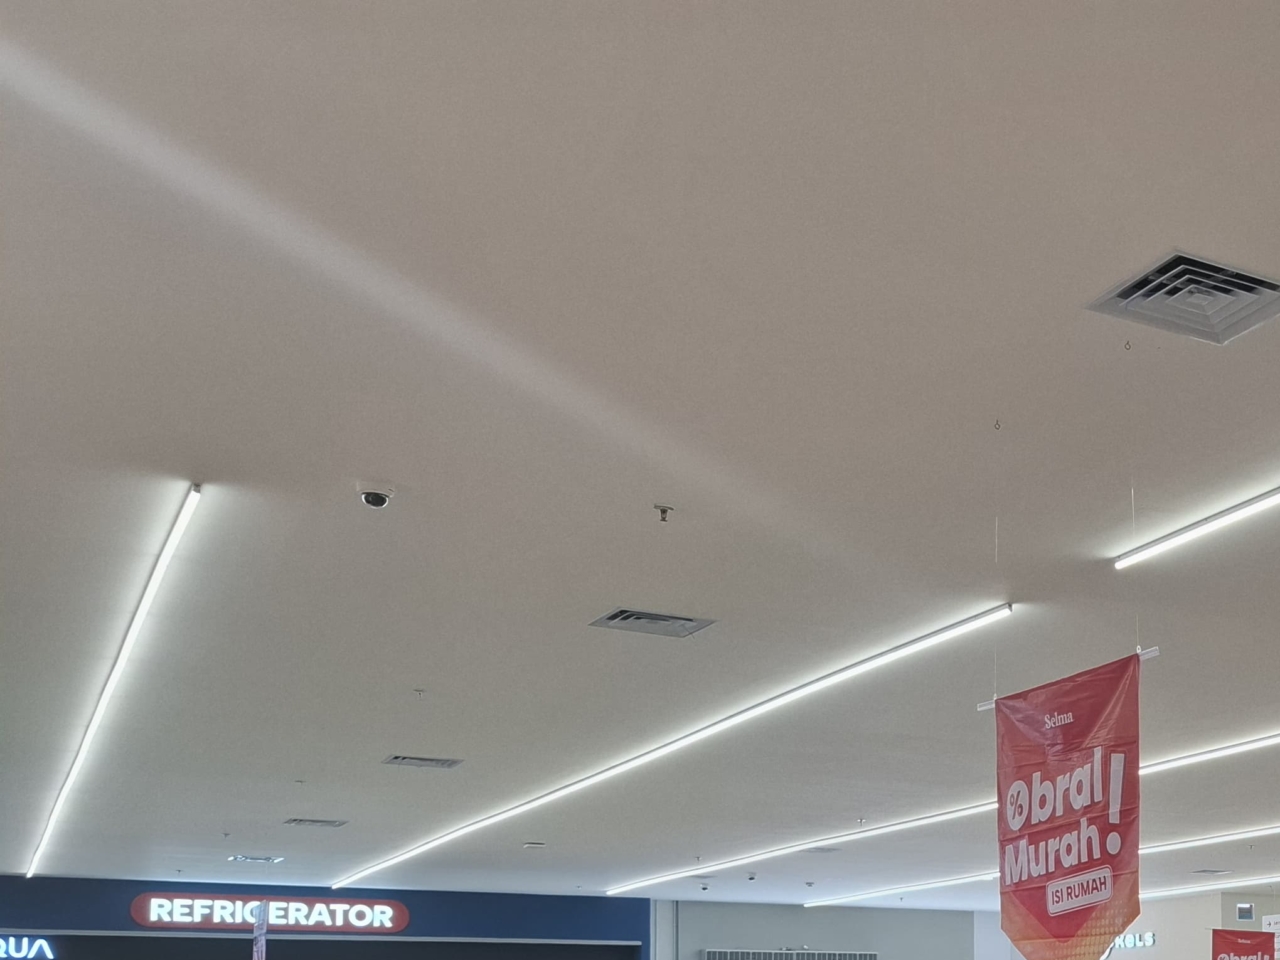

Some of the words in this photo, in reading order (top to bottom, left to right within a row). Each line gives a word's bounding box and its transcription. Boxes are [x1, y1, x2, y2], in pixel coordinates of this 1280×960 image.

[1044, 709, 1074, 729] Selma
[1005, 745, 1104, 831] Obral
[1050, 888, 1065, 906] ISI
[1066, 875, 1108, 902] RUMAH
